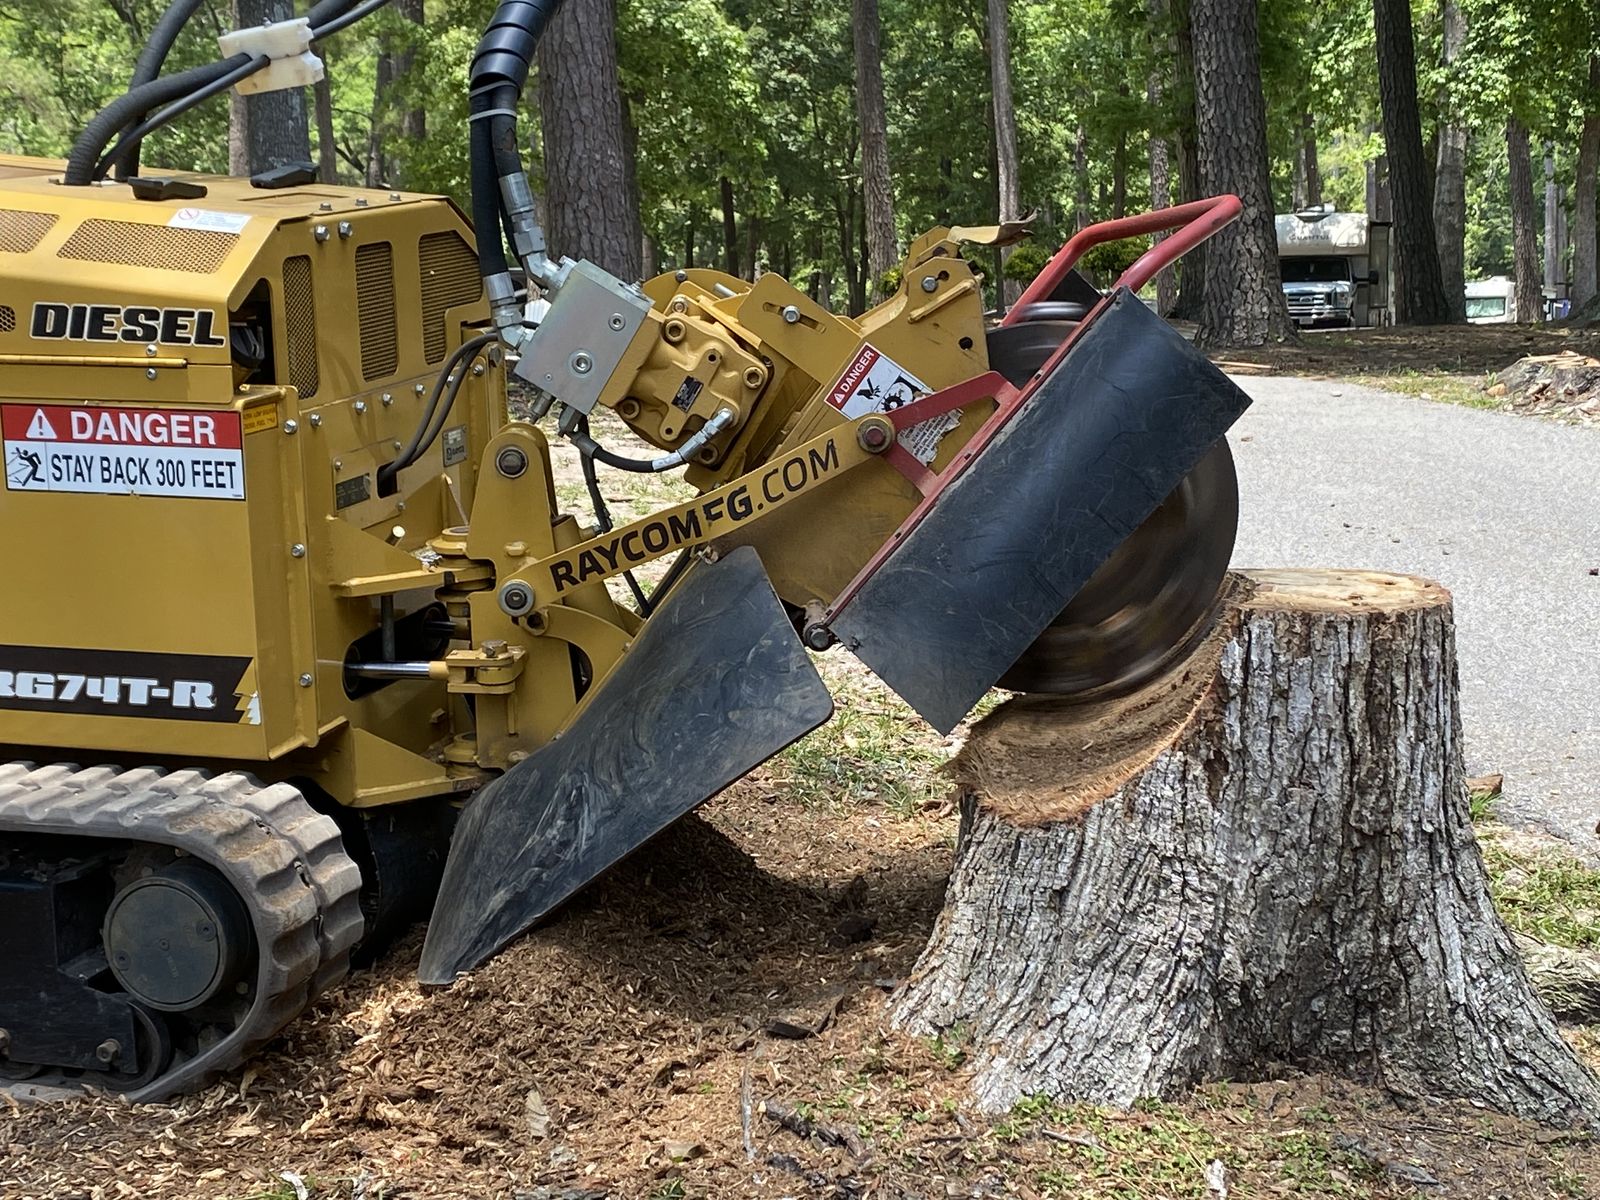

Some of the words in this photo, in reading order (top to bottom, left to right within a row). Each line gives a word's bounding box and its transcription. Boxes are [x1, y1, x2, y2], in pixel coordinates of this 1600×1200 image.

[30, 302, 226, 347] DIESEL
[840, 350, 875, 393] DANGER
[70, 411, 216, 445] DANGER
[51, 453, 94, 483] STAY
[100, 456, 151, 486] BACK
[156, 459, 186, 488] 300
[191, 460, 236, 489] FEET
[549, 439, 839, 592] RAYCOMFG.COM
